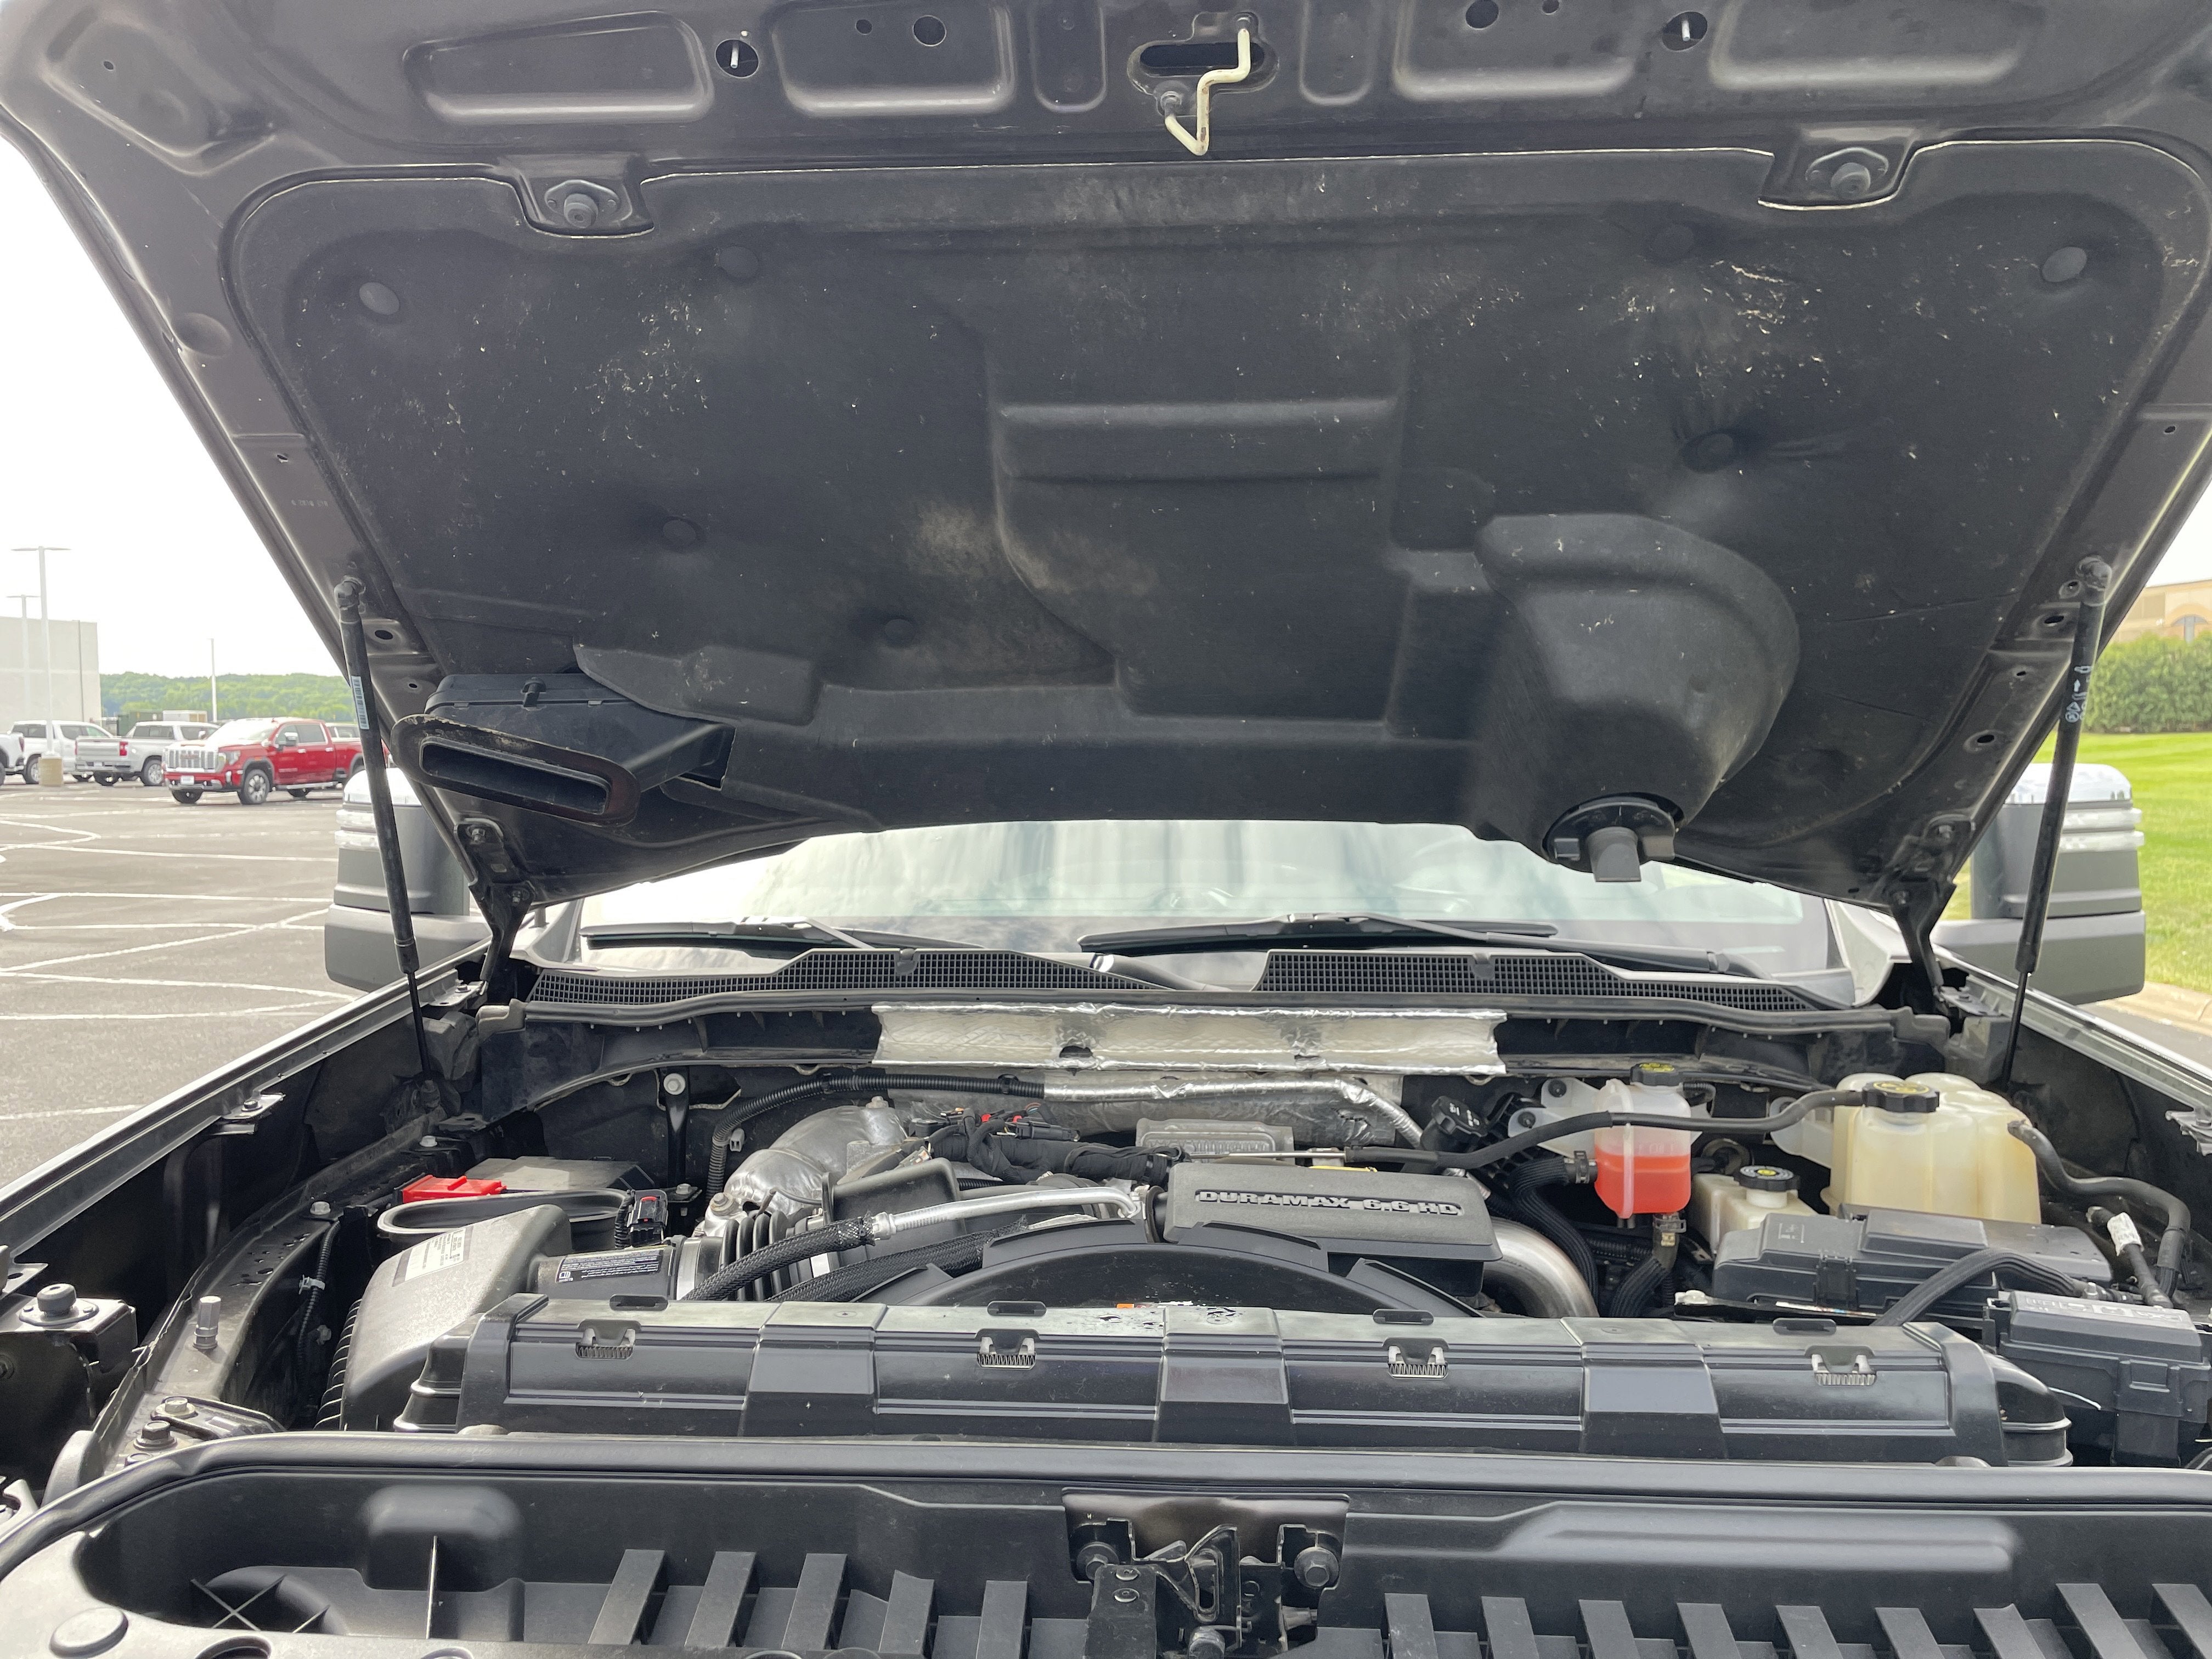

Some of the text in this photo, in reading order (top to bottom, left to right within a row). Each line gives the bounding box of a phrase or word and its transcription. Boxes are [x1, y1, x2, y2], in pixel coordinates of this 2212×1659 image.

[1199, 1191, 1458, 1215] DURAMAX 6.6 HD
